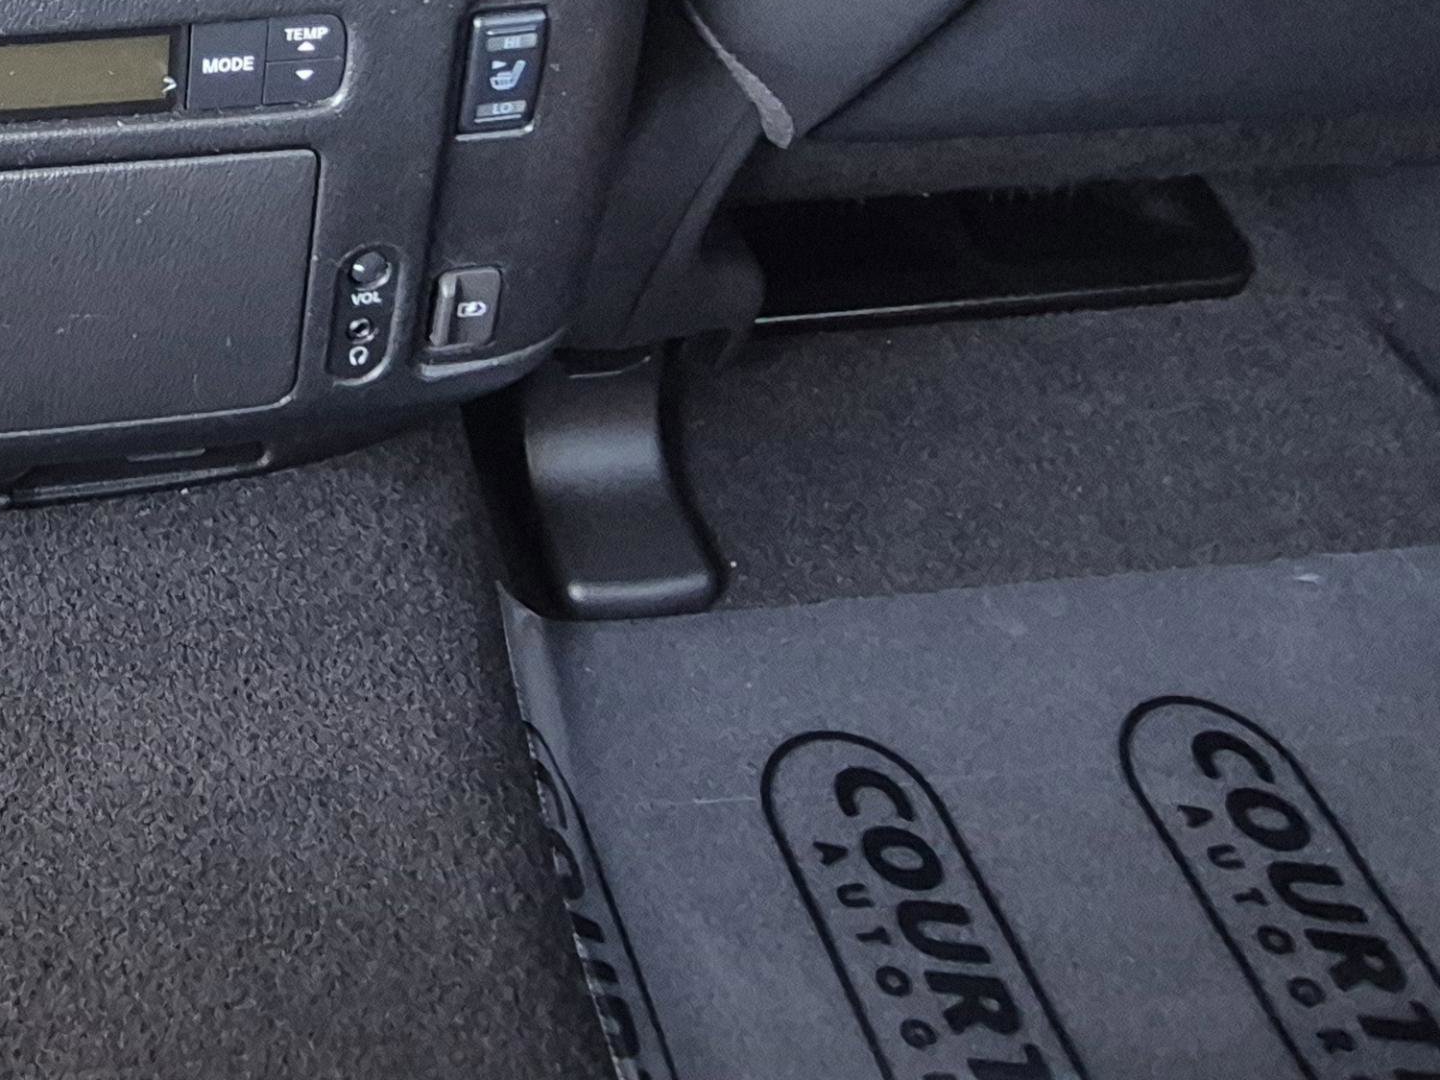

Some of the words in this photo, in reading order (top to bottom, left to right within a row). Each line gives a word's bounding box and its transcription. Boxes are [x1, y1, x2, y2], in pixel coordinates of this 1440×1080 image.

[284, 24, 329, 42] TEMP
[202, 53, 255, 75] MODE
[350, 291, 382, 306] VOL
[1190, 729, 1440, 1080] COURT
